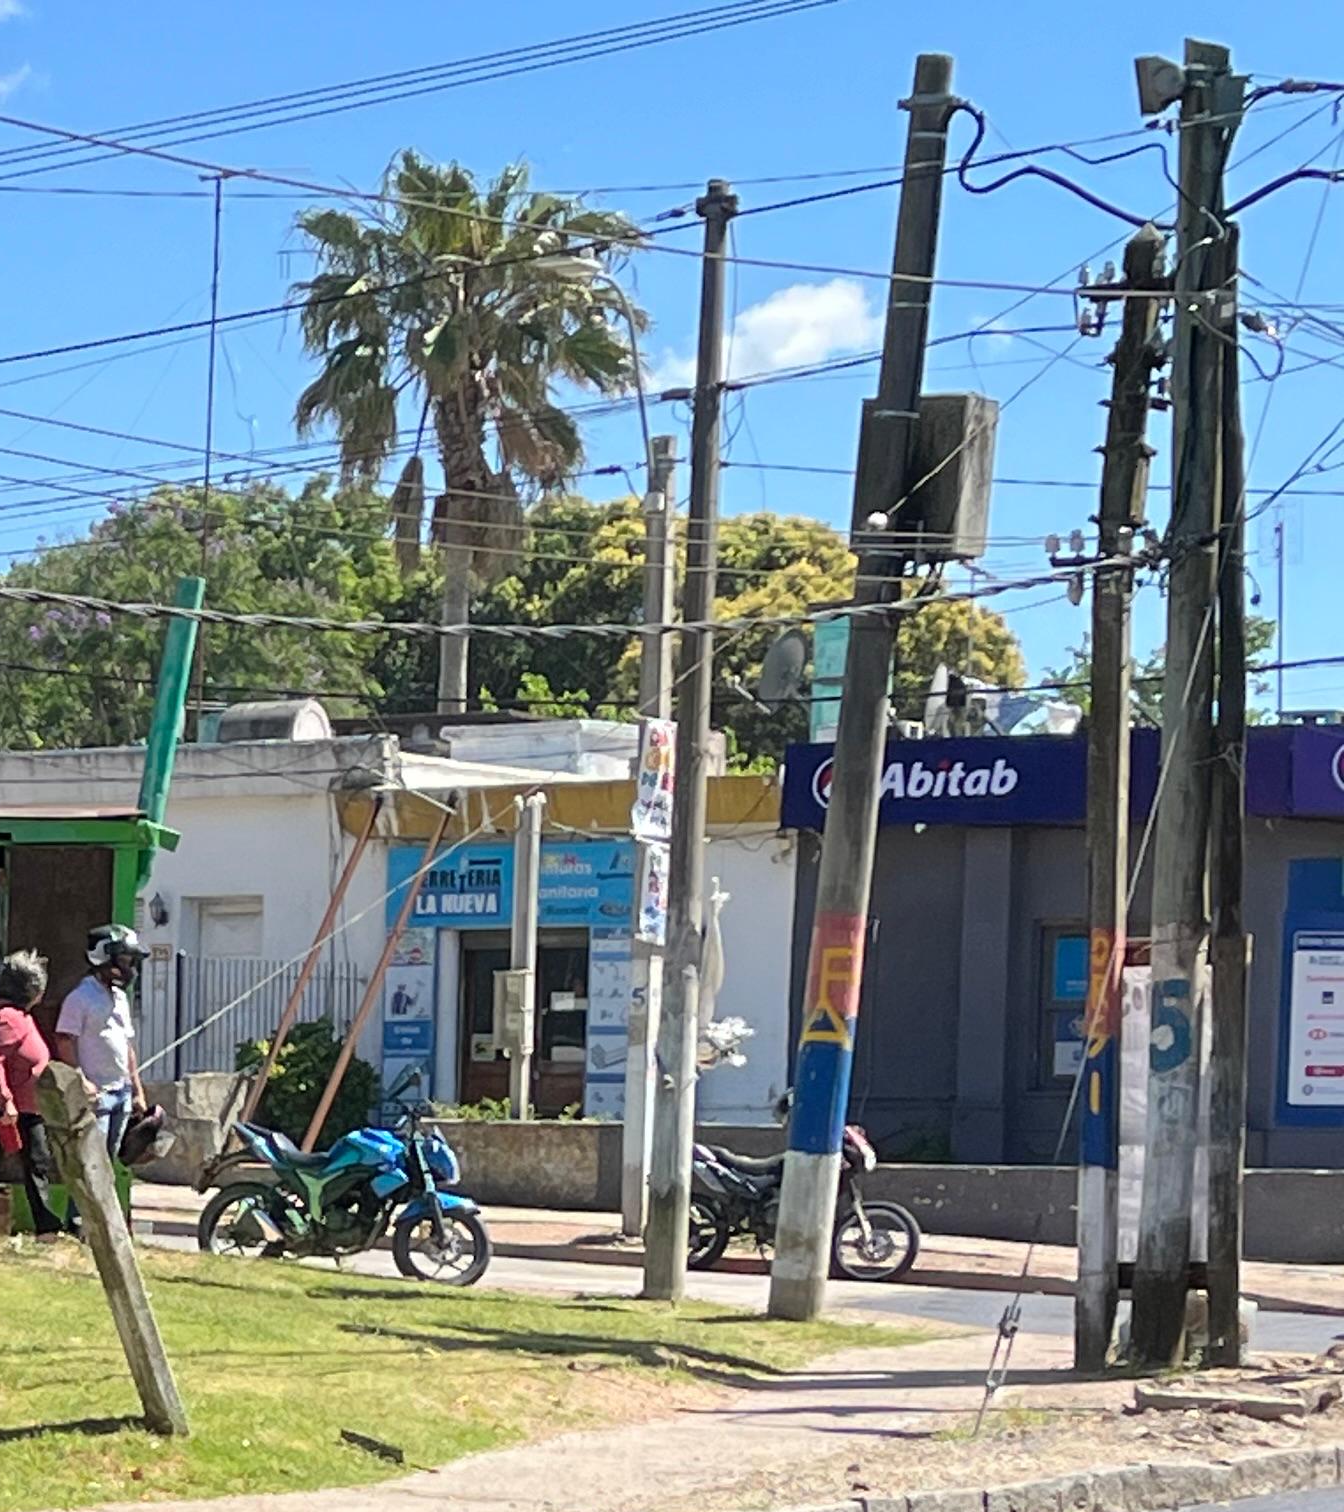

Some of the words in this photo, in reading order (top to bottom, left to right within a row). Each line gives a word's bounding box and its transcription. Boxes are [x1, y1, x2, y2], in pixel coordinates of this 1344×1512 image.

[879, 759, 1018, 798] Abitab
[415, 893, 437, 915] LA
[441, 893, 498, 914] NUEVA
[539, 886, 599, 899] anitaria
[1149, 978, 1192, 1073] 5
